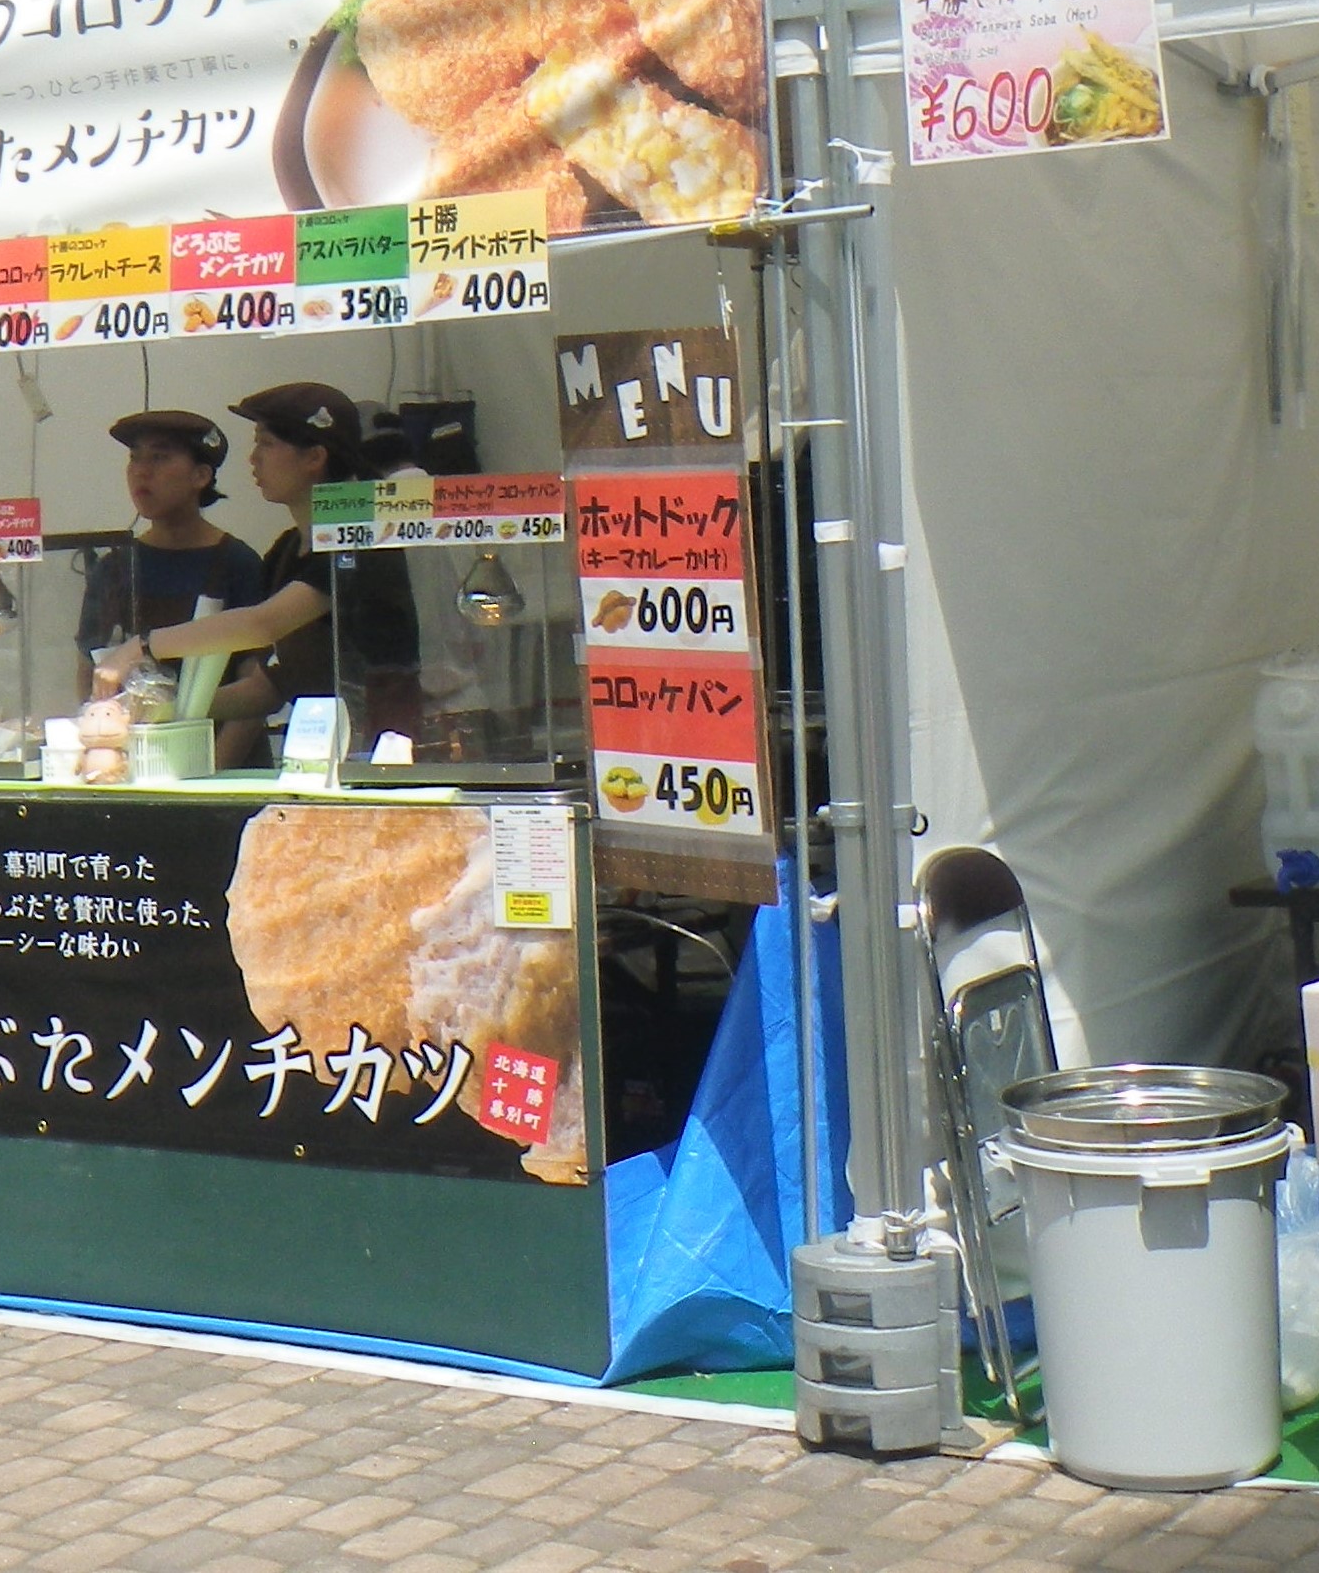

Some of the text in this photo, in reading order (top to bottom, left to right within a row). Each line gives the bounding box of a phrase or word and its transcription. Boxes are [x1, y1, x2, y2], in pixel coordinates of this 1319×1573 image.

[1030, 13, 1057, 27] Soba
[920, 66, 1054, 143] ¥600
[409, 202, 459, 236] 十勝
[171, 230, 242, 258] どろぶた
[297, 234, 408, 263] アスパラバター
[411, 227, 547, 265] フライドポテト
[50, 254, 163, 284] ラクレットチーズ
[199, 251, 286, 280] メンチカツ
[340, 284, 409, 323] 350円
[461, 268, 550, 314] 400円
[94, 300, 170, 340] 400円
[216, 289, 296, 331] 400円
[559, 340, 733, 441] MENU
[396, 521, 433, 540] 400円
[454, 518, 494, 539] 600円
[522, 517, 562, 537] 450円
[580, 493, 740, 538] ホットドック
[337, 525, 375, 545] 350円
[637, 585, 735, 635] 600円
[590, 675, 744, 716] コロッケパン
[655, 760, 755, 818] 450円
[493, 1054, 547, 1086] 北海道
[489, 1098, 542, 1130] 幕別町
